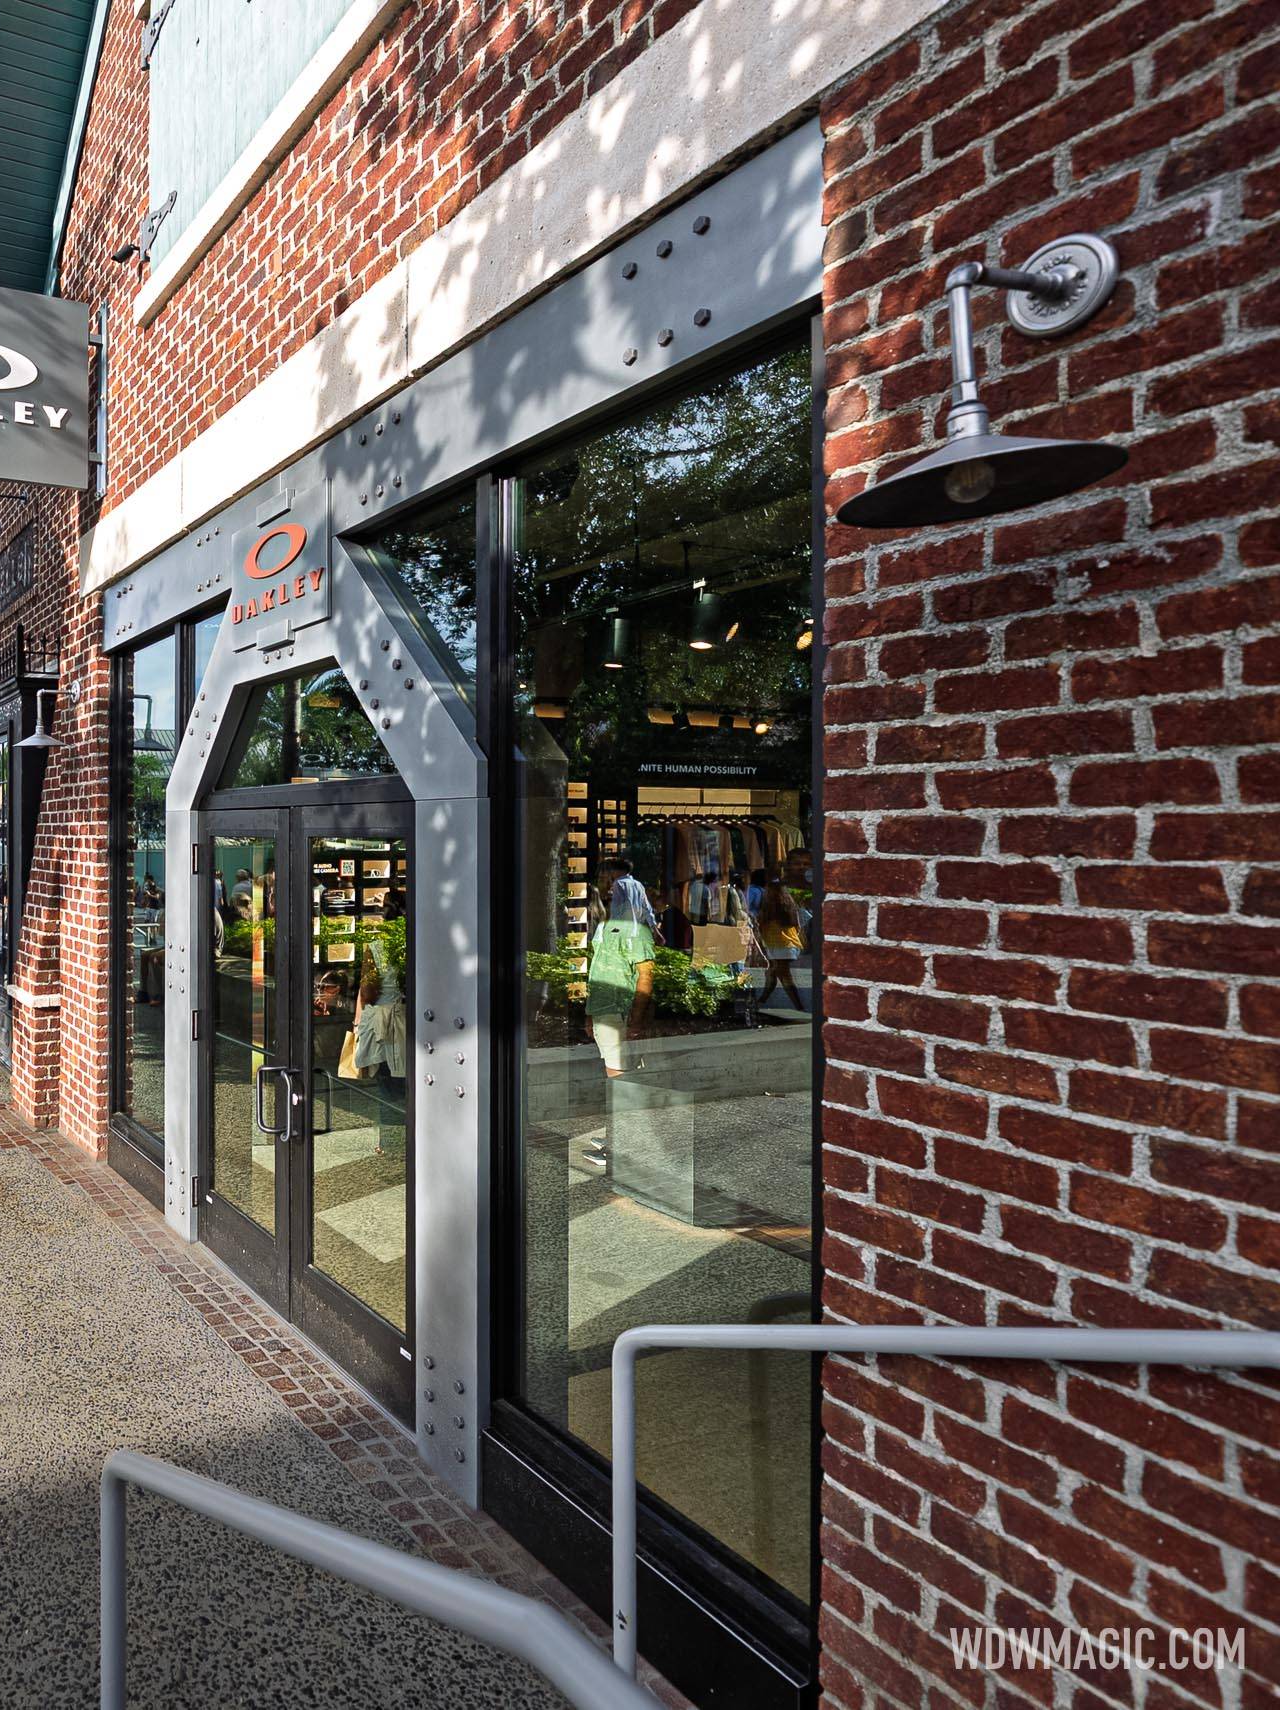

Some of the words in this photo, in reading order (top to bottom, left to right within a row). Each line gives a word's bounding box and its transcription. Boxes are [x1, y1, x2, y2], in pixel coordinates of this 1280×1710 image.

[231, 567, 325, 625] OAKLEY
[638, 764, 663, 773] NITE
[665, 764, 702, 774] HUMAN
[703, 765, 758, 775] POSSIBILITY
